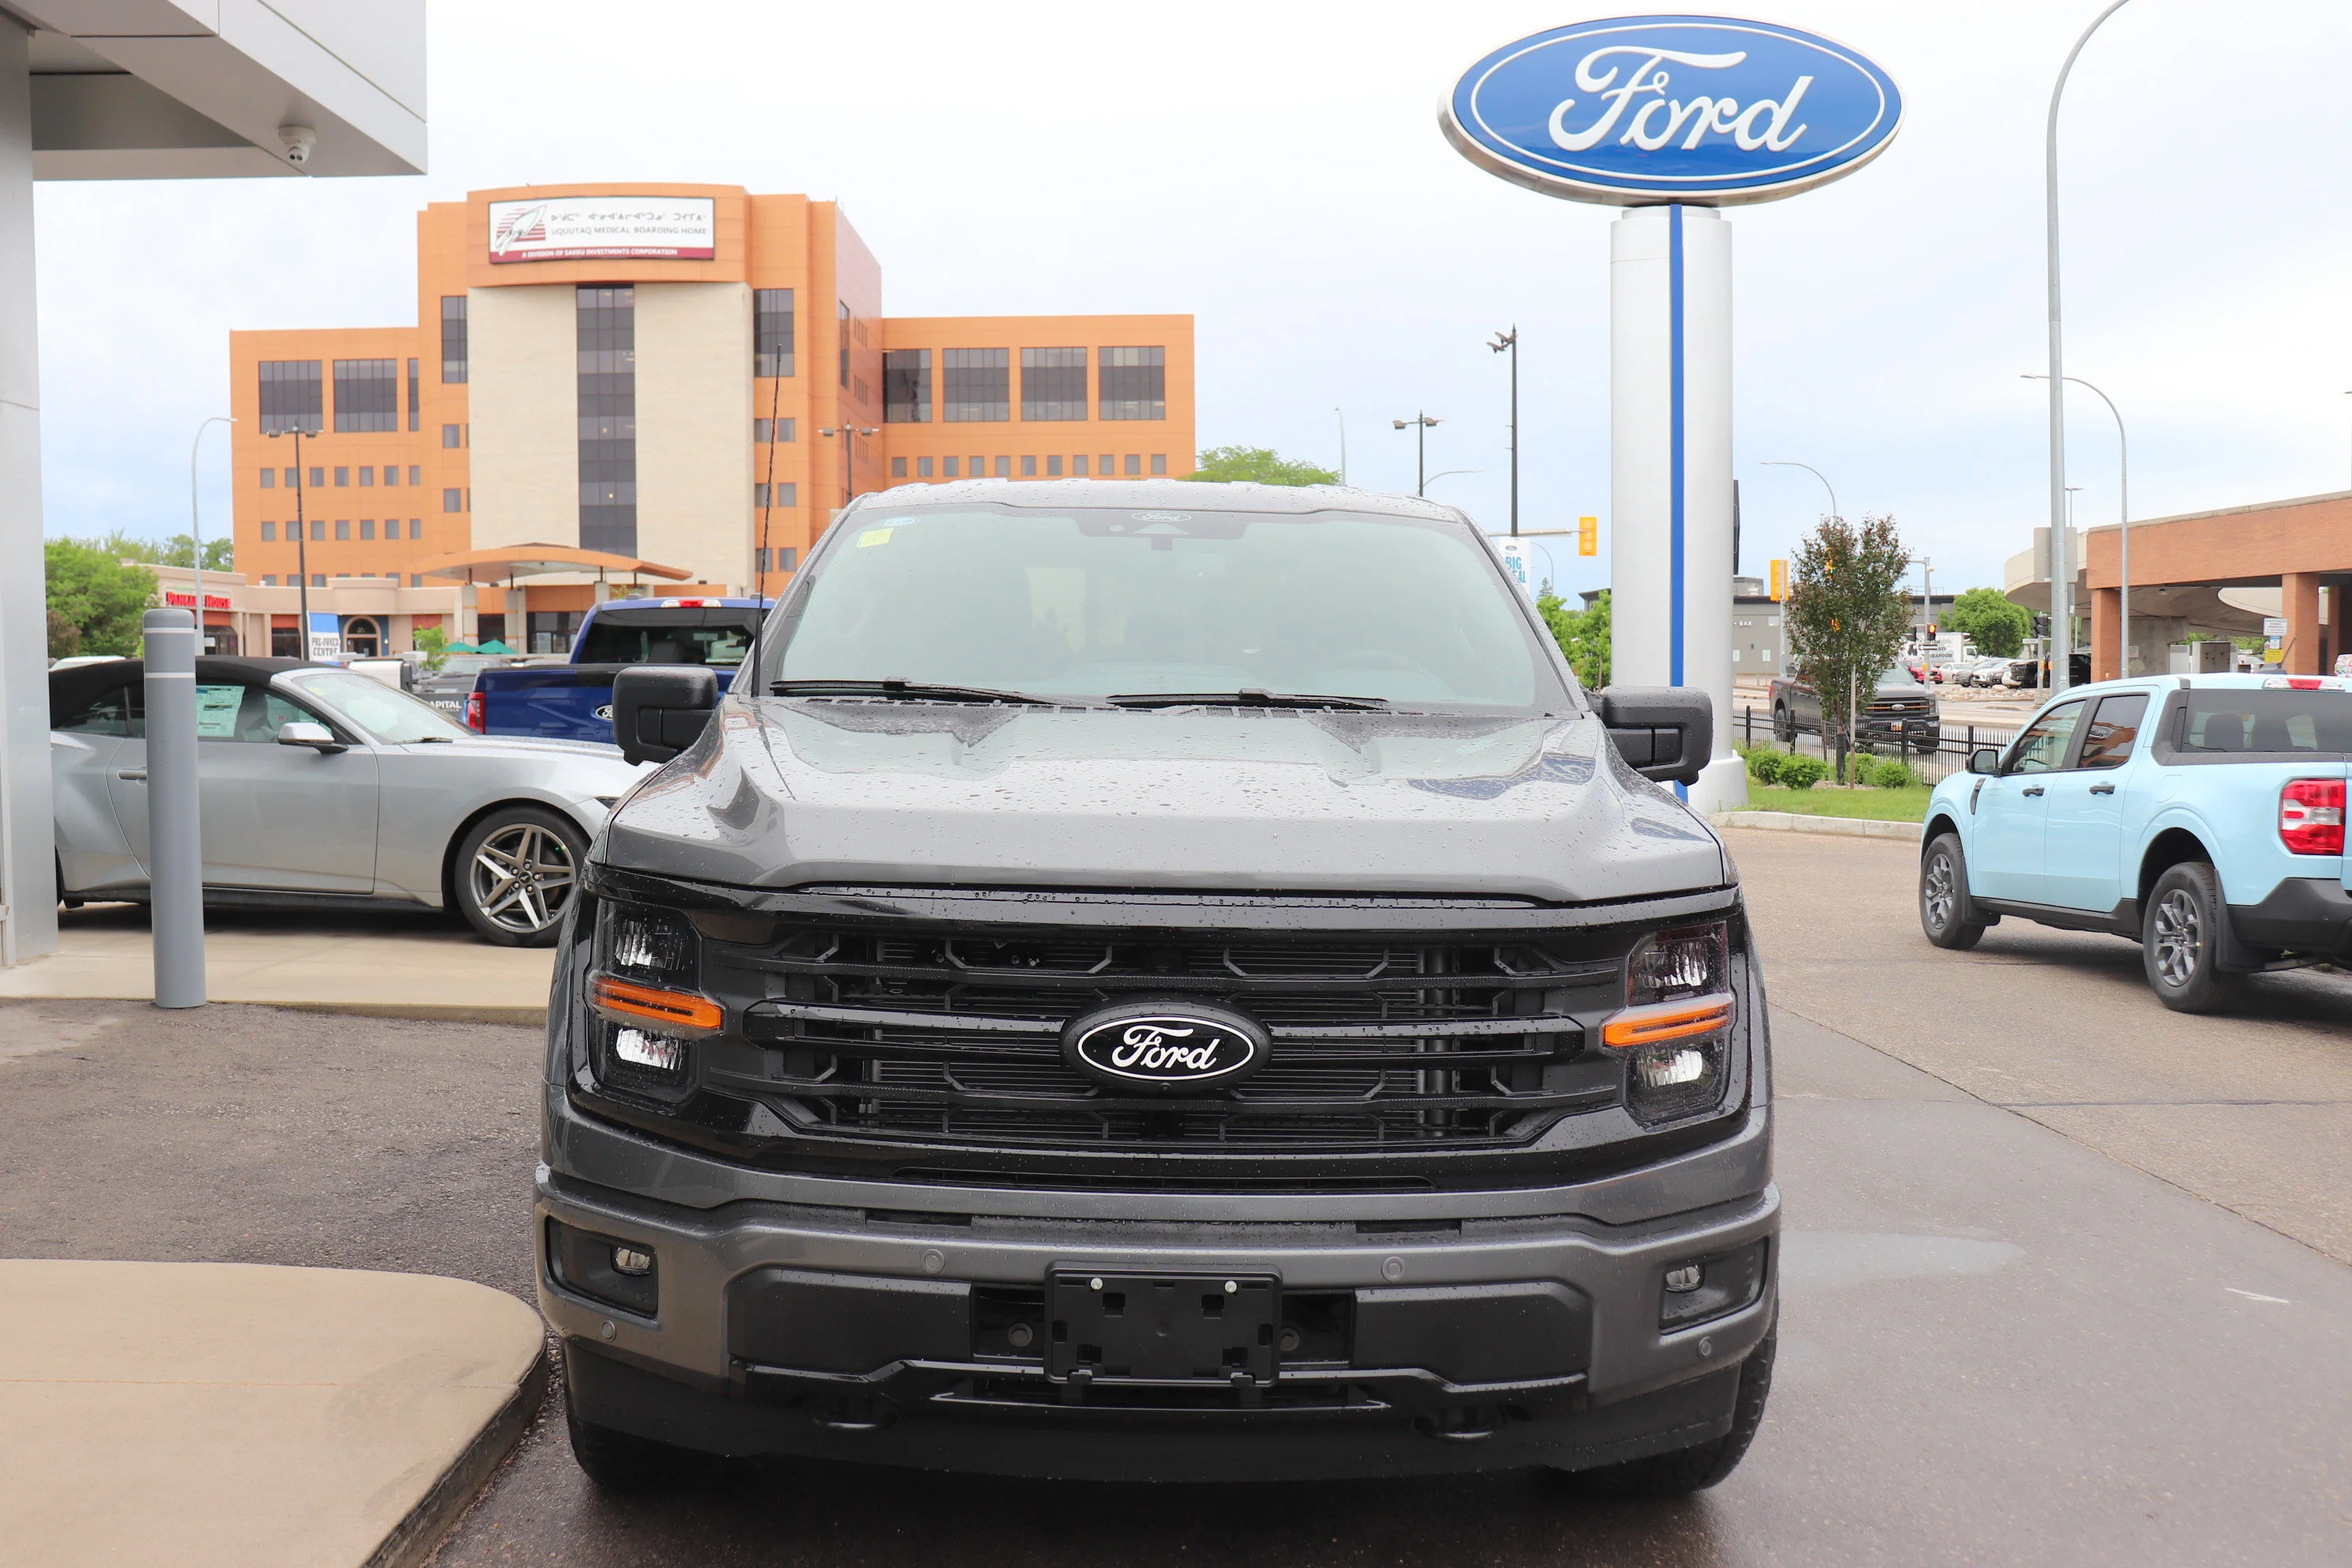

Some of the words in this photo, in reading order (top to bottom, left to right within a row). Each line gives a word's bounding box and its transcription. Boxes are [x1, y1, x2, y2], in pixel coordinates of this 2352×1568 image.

[1548, 45, 1814, 152] Ford
[634, 226, 679, 235] BOARDING
[205, 595, 231, 609] HOUSE
[311, 637, 339, 646] PRE-OWNED
[1111, 1025, 1220, 1070] Ford
